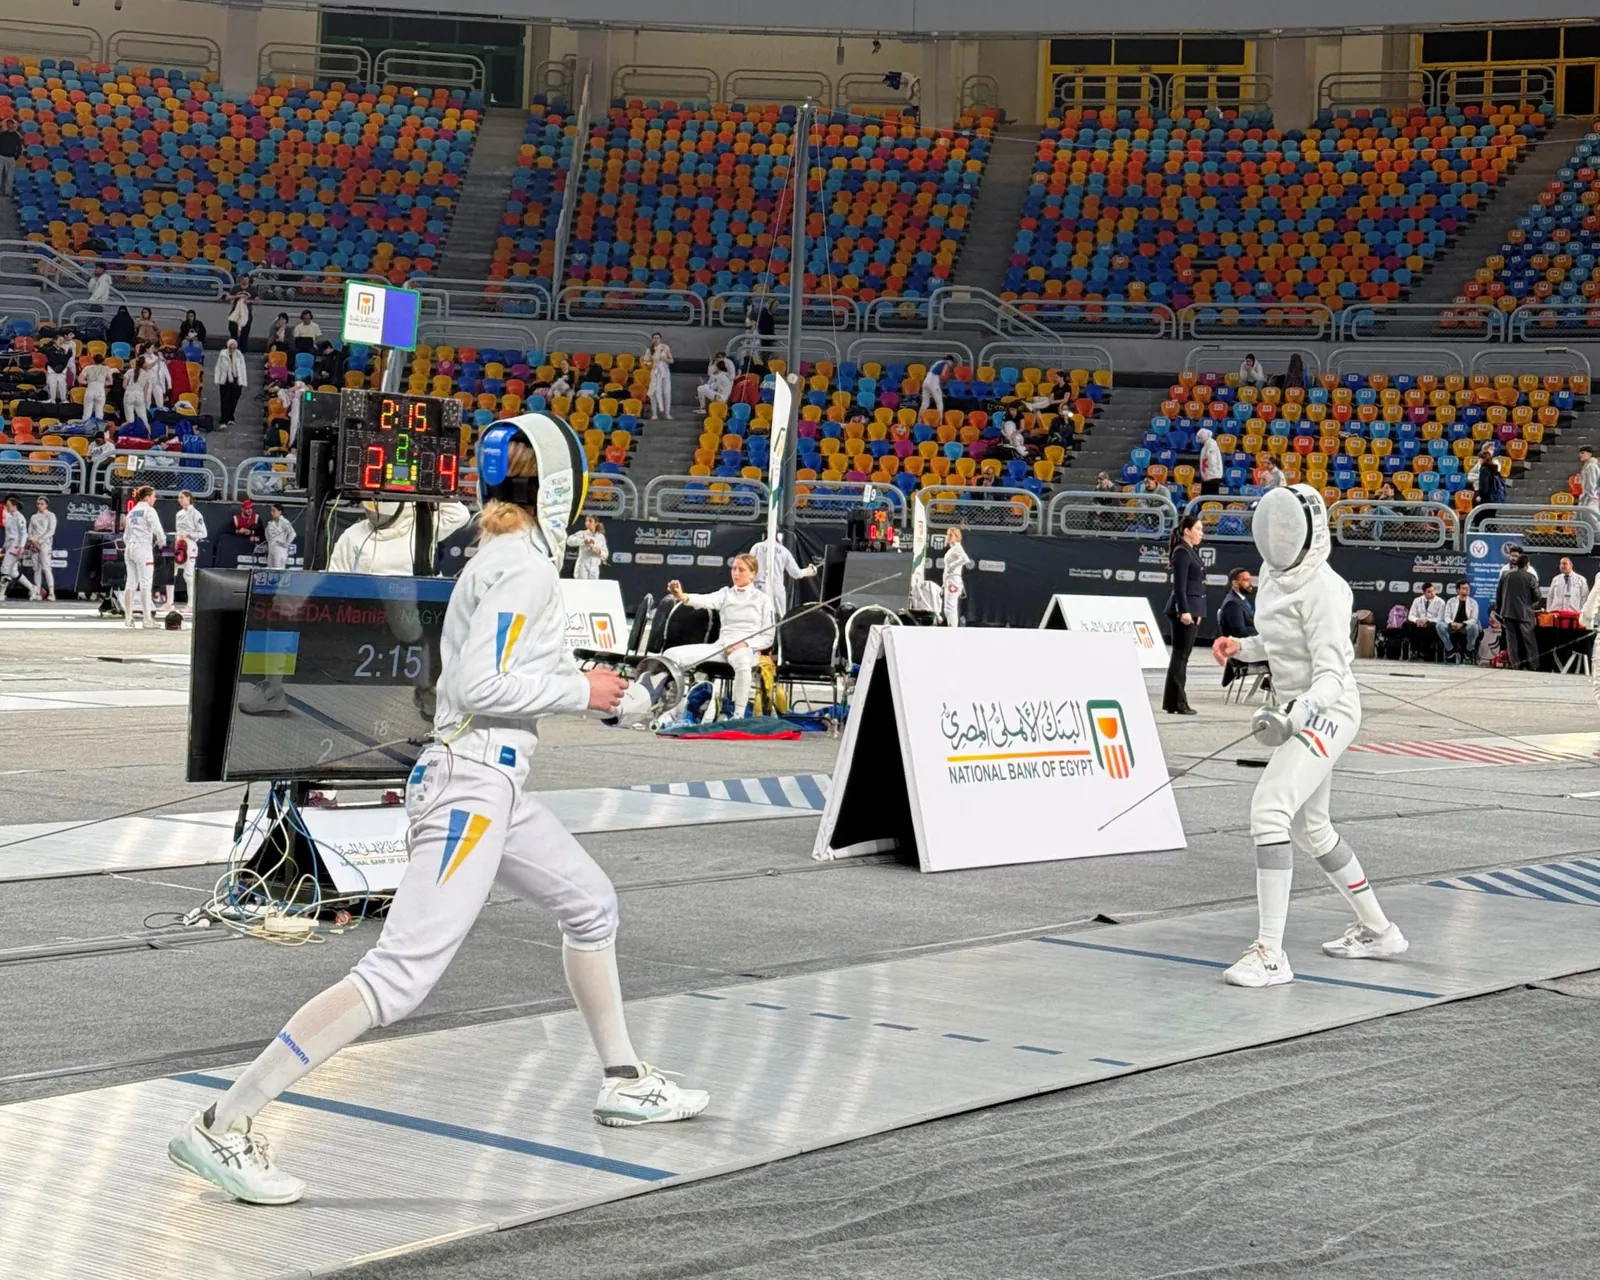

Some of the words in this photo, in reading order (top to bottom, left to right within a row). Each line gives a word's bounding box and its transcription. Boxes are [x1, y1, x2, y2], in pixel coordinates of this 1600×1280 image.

[381, 399, 427, 432] 2:15
[396, 433, 409, 463] 2
[138, 459, 144, 469] 7
[364, 446, 385, 488] 2
[440, 453, 457, 491] 4
[871, 489, 877, 501] 9
[401, 609, 442, 625] NAGY
[354, 644, 422, 679] 2:15
[372, 719, 389, 737] 18
[948, 763, 1007, 785] NATIONAL
[1008, 762, 1040, 780] BANK
[1042, 761, 1057, 779] OF
[1060, 759, 1095, 777] EGYPT
